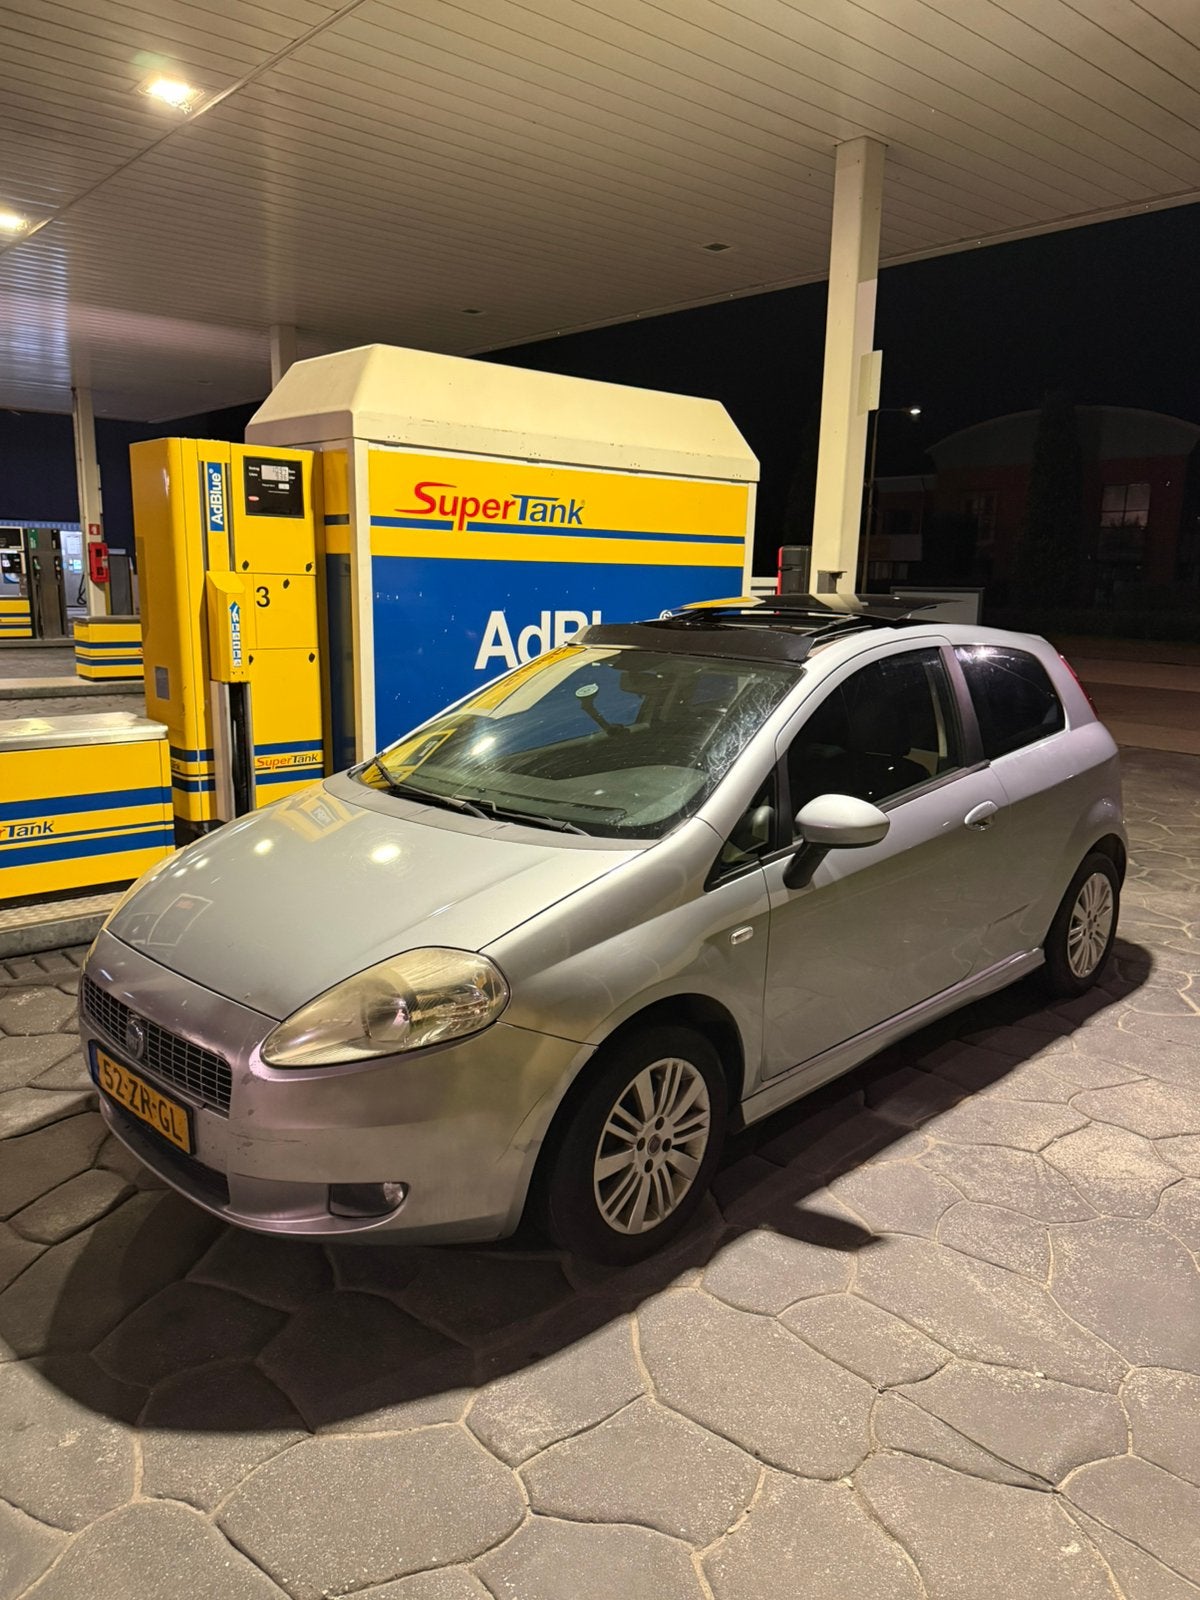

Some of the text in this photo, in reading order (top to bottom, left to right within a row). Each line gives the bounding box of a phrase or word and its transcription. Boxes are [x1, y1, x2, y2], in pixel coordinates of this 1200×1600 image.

[209, 472, 224, 525] AdBlue
[394, 481, 585, 531] SuperTank
[256, 586, 270, 608] 3
[256, 752, 319, 769] SuperTank
[103, 1058, 183, 1142] 52-ZR-GL
